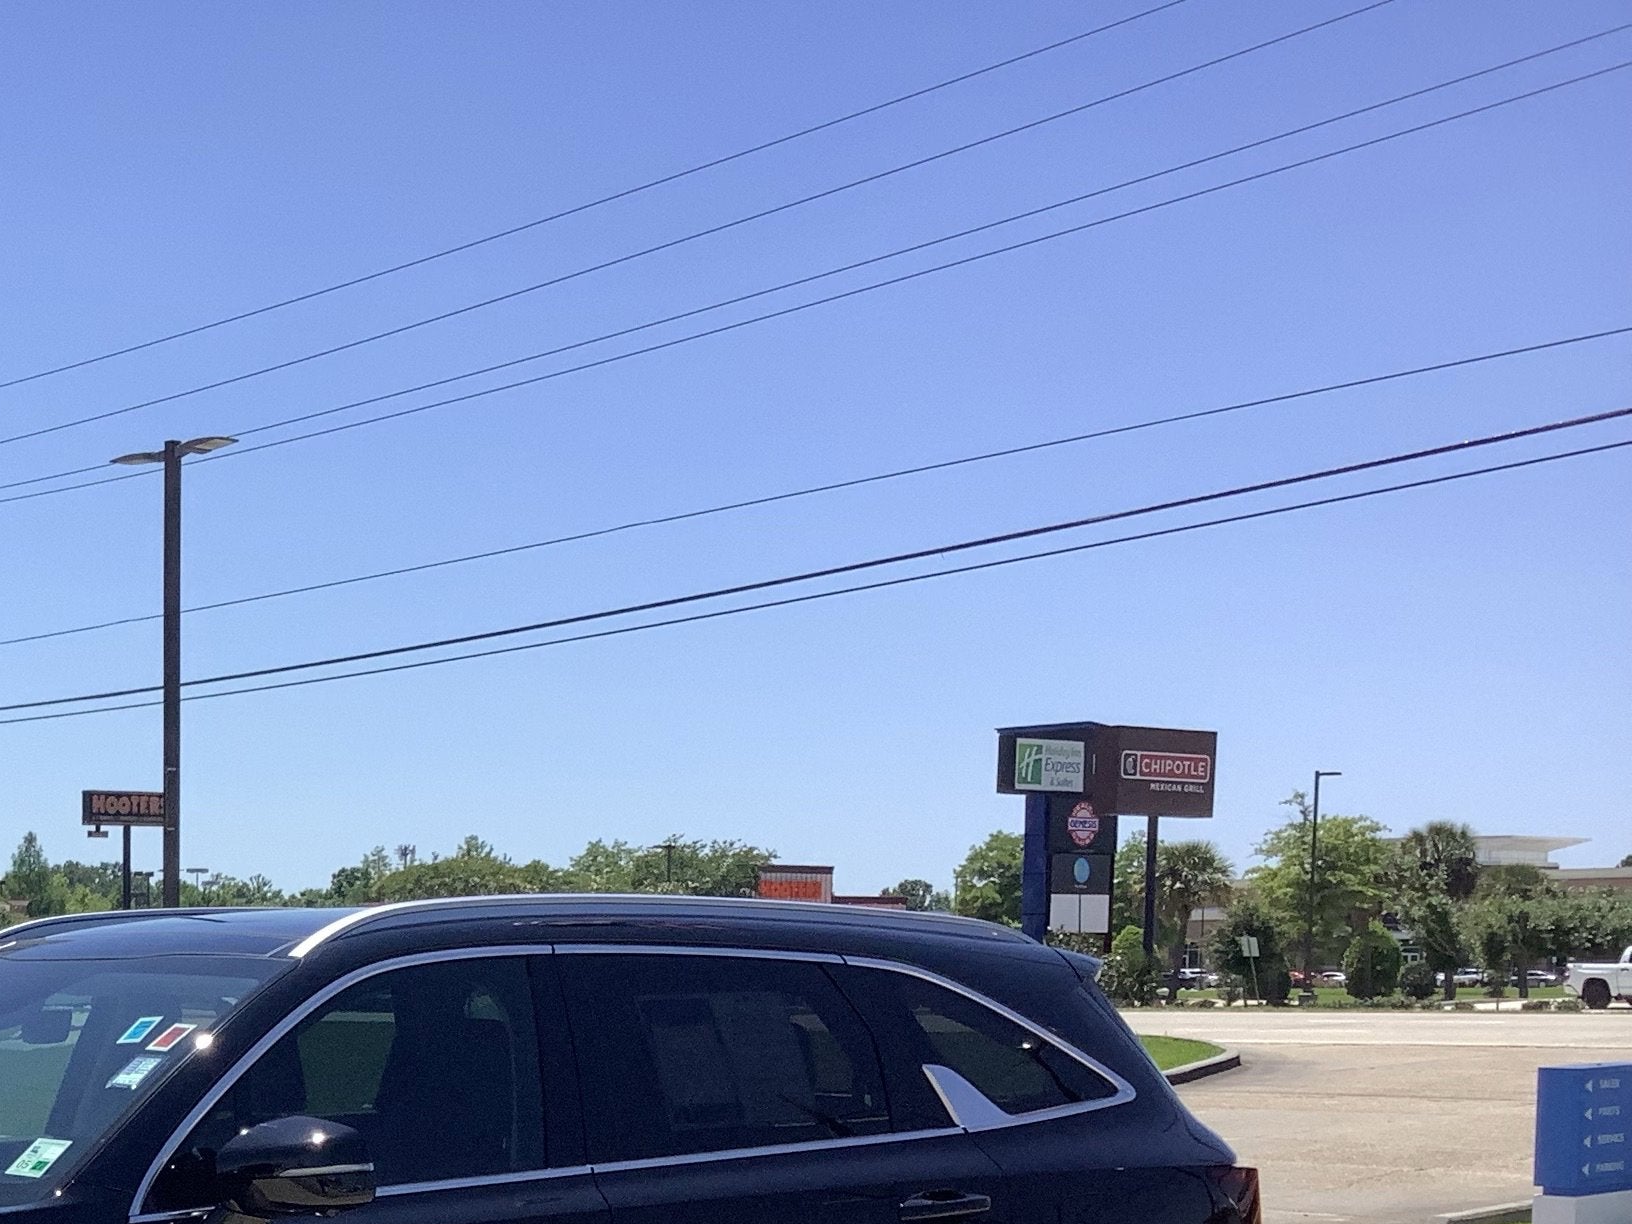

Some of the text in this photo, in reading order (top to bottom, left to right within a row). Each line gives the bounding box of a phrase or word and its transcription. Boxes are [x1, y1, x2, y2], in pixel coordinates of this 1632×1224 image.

[1044, 756, 1082, 776] Express
[1141, 758, 1206, 776] CHIPOTLE
[1149, 782, 1205, 793] MEXICAN GRILL
[91, 794, 164, 816] HOOTER
